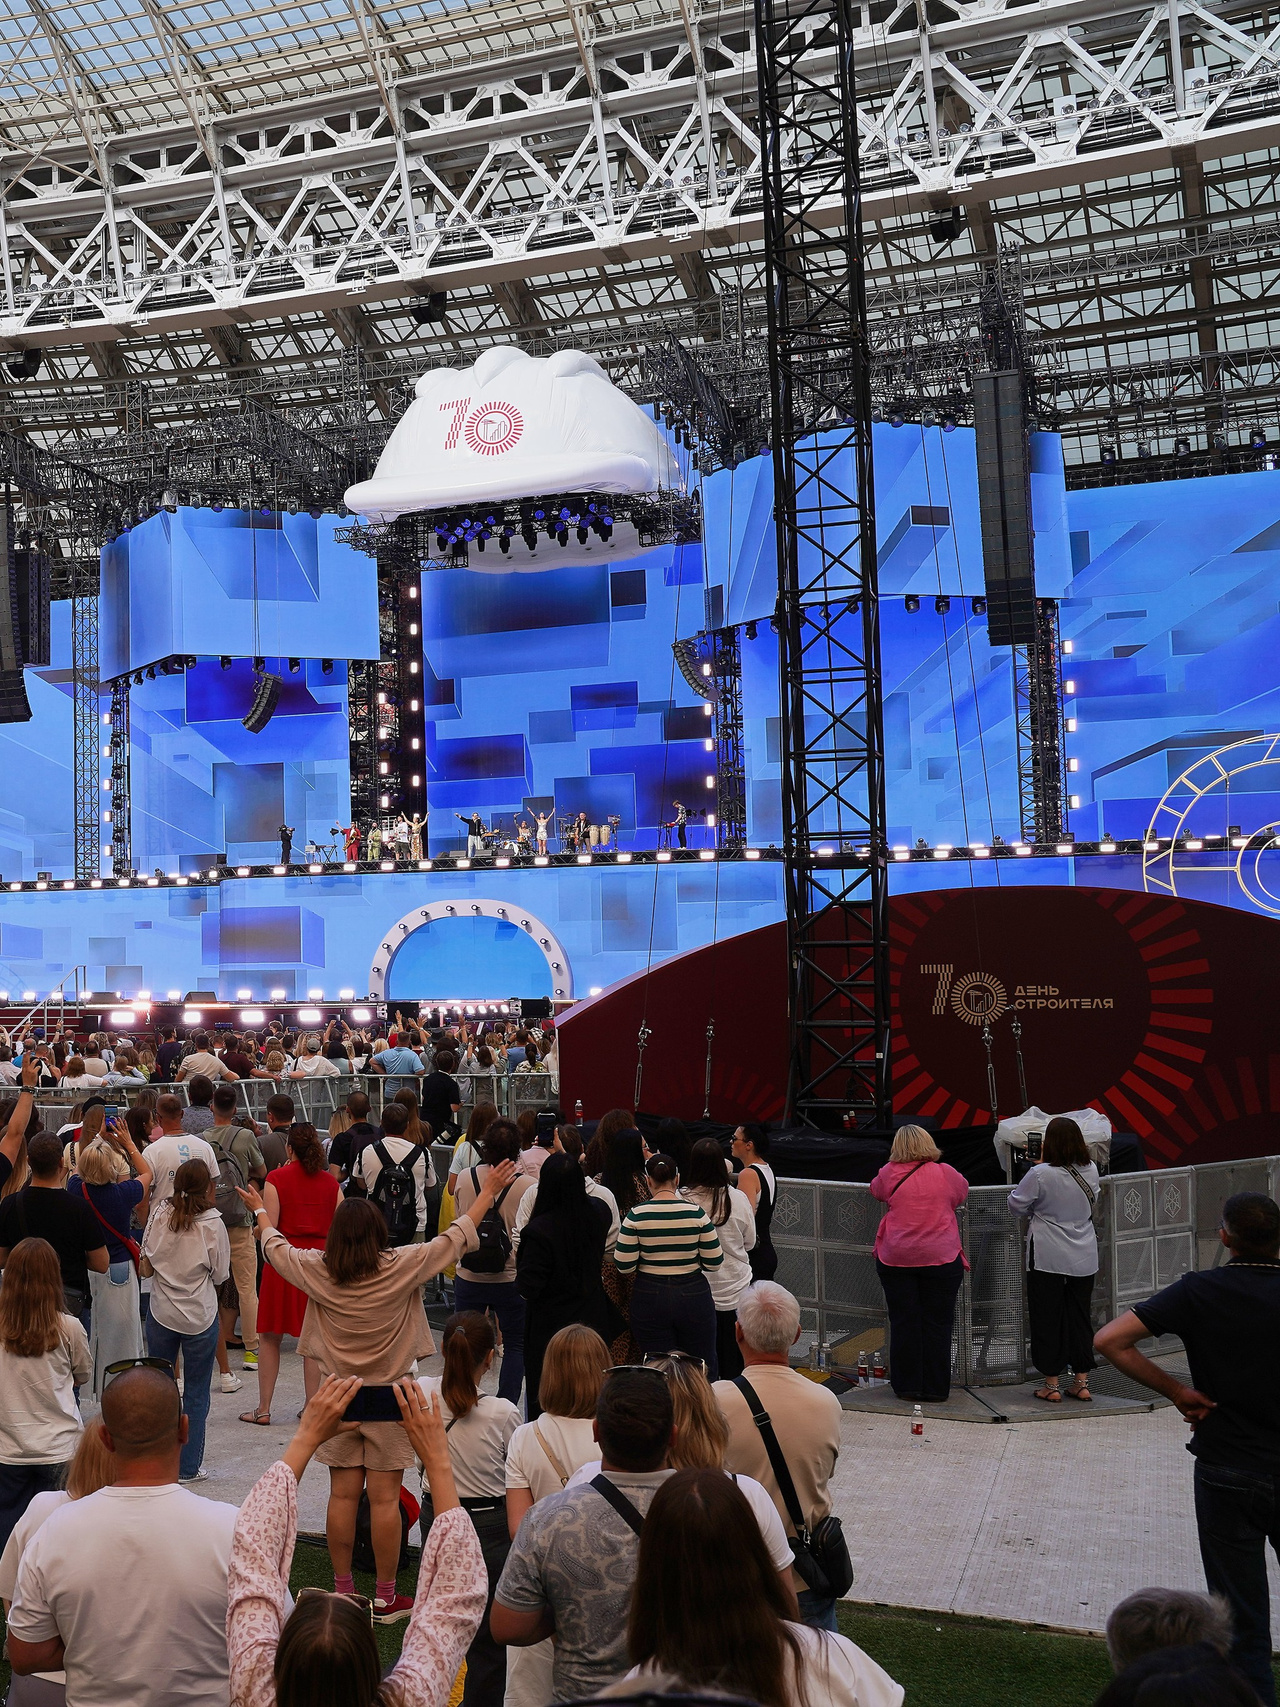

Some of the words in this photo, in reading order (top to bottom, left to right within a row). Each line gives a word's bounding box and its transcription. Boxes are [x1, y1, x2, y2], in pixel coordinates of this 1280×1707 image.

[439, 397, 524, 456] 70
[920, 963, 1008, 1026] 70
[1014, 985, 1060, 996] ДЕНЬ
[1014, 998, 1114, 1010] СТРОИТЕЛЯ
